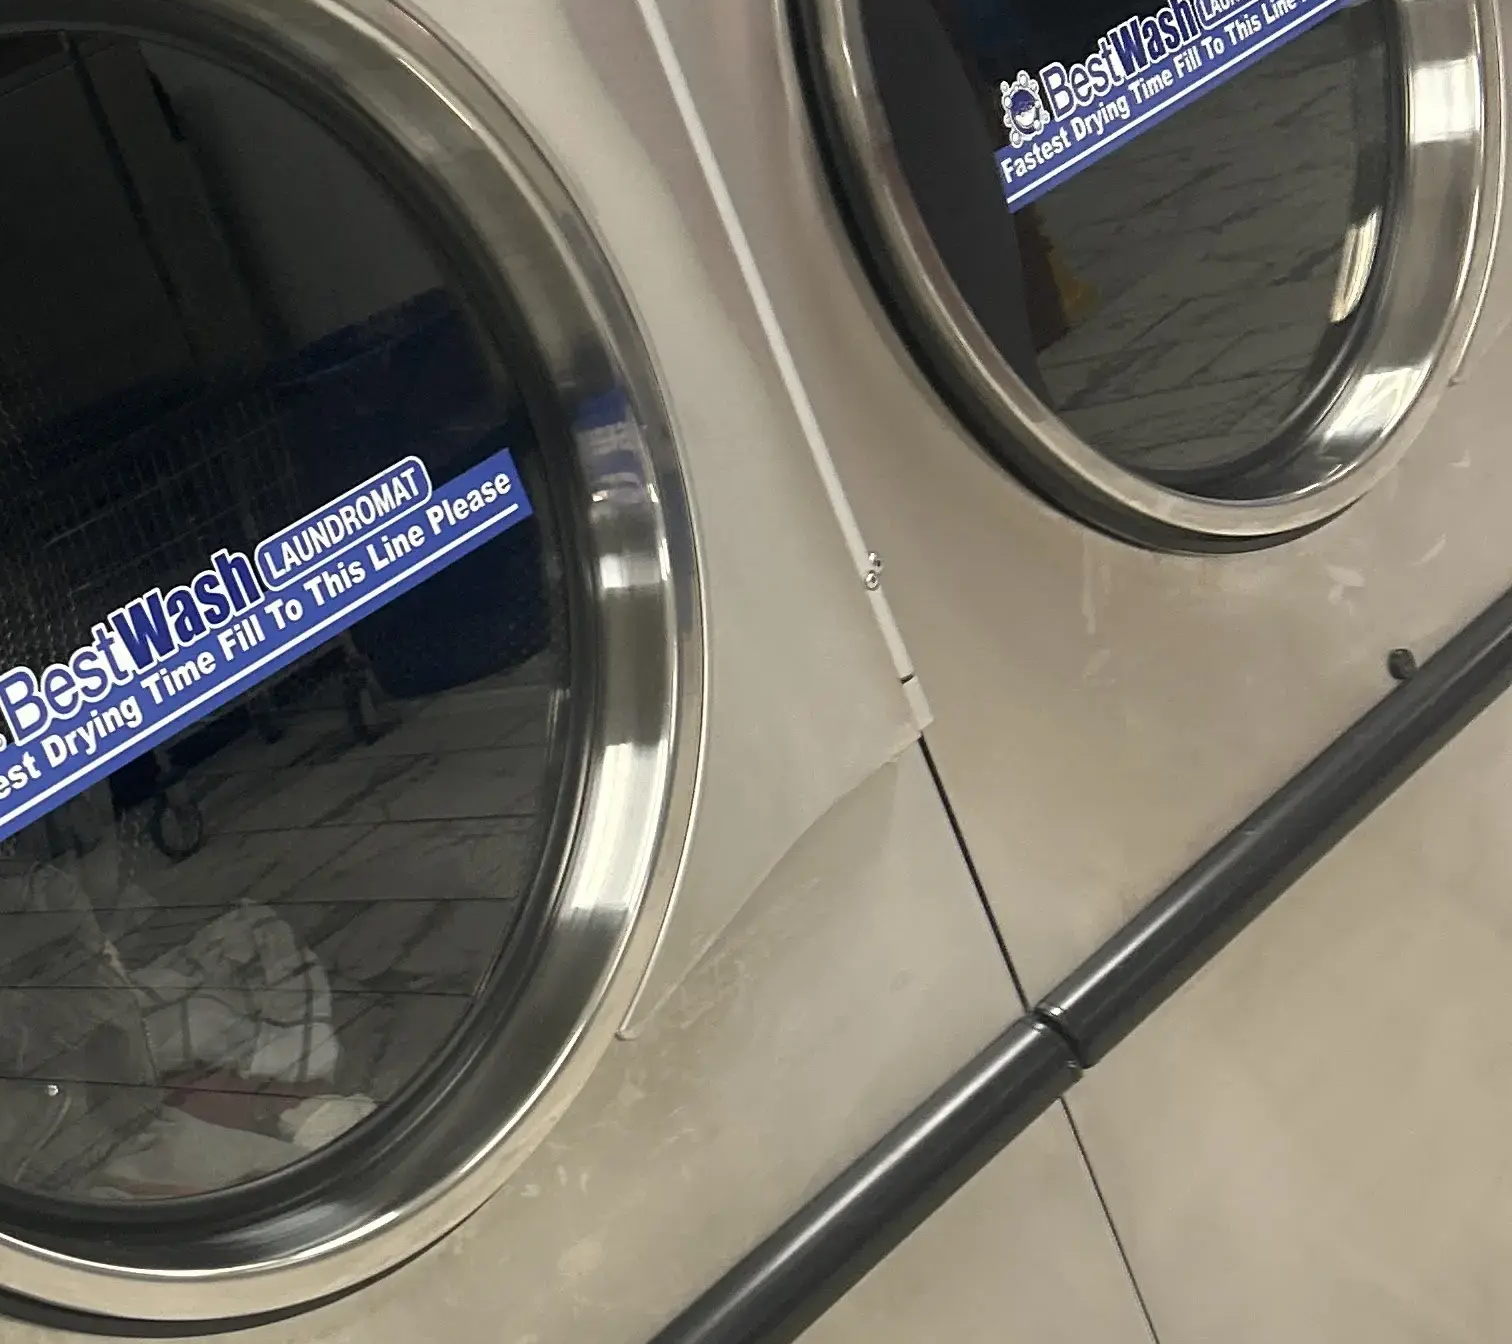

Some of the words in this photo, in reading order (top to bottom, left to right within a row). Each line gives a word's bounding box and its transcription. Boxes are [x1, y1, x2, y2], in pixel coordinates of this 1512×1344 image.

[1000, 127, 1072, 184] Fastest
[1070, 96, 1131, 141] Drying
[1128, 71, 1174, 106] Time
[1174, 48, 1203, 82] Fill
[1200, 34, 1226, 60] To
[1223, 11, 1263, 46] This
[262, 466, 420, 580] LAUNDROMAT
[40, 694, 142, 768] Drying
[139, 649, 217, 706] Time
[216, 612, 266, 663] Fill
[264, 598, 305, 632] To
[303, 560, 367, 607] This
[365, 523, 426, 573] Line
[424, 472, 511, 536] Please
